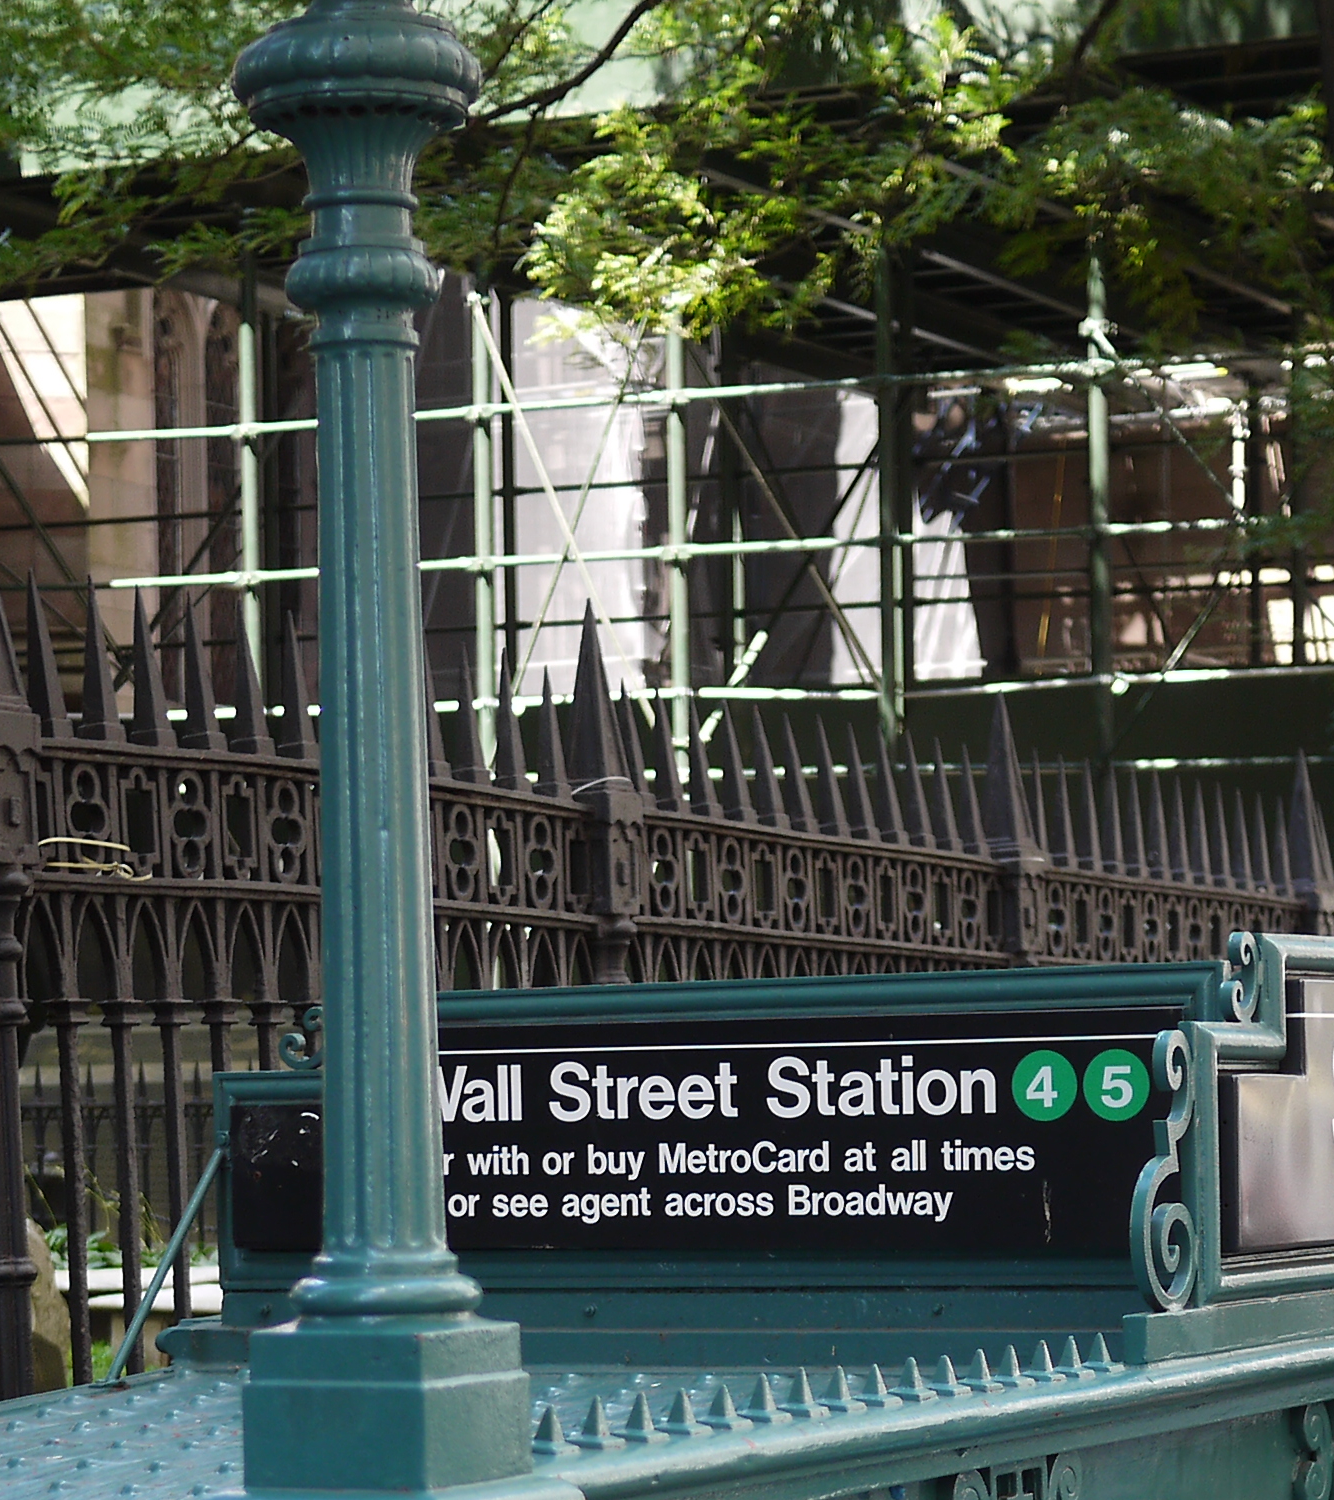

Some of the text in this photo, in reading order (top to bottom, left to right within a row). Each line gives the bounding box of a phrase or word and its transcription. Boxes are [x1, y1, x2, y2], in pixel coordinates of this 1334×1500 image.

[548, 1060, 739, 1123] Street
[767, 1055, 997, 1120] Station
[1026, 1065, 1058, 1108] 4
[1100, 1065, 1133, 1107] 5
[467, 1145, 530, 1176] with
[542, 1151, 575, 1176] or
[587, 1143, 645, 1181] buy
[658, 1140, 830, 1174] MetroCard
[844, 1147, 876, 1173] at
[891, 1139, 926, 1173] all
[941, 1139, 1035, 1173] times
[447, 1185, 953, 1225] or see agent across Broadway
